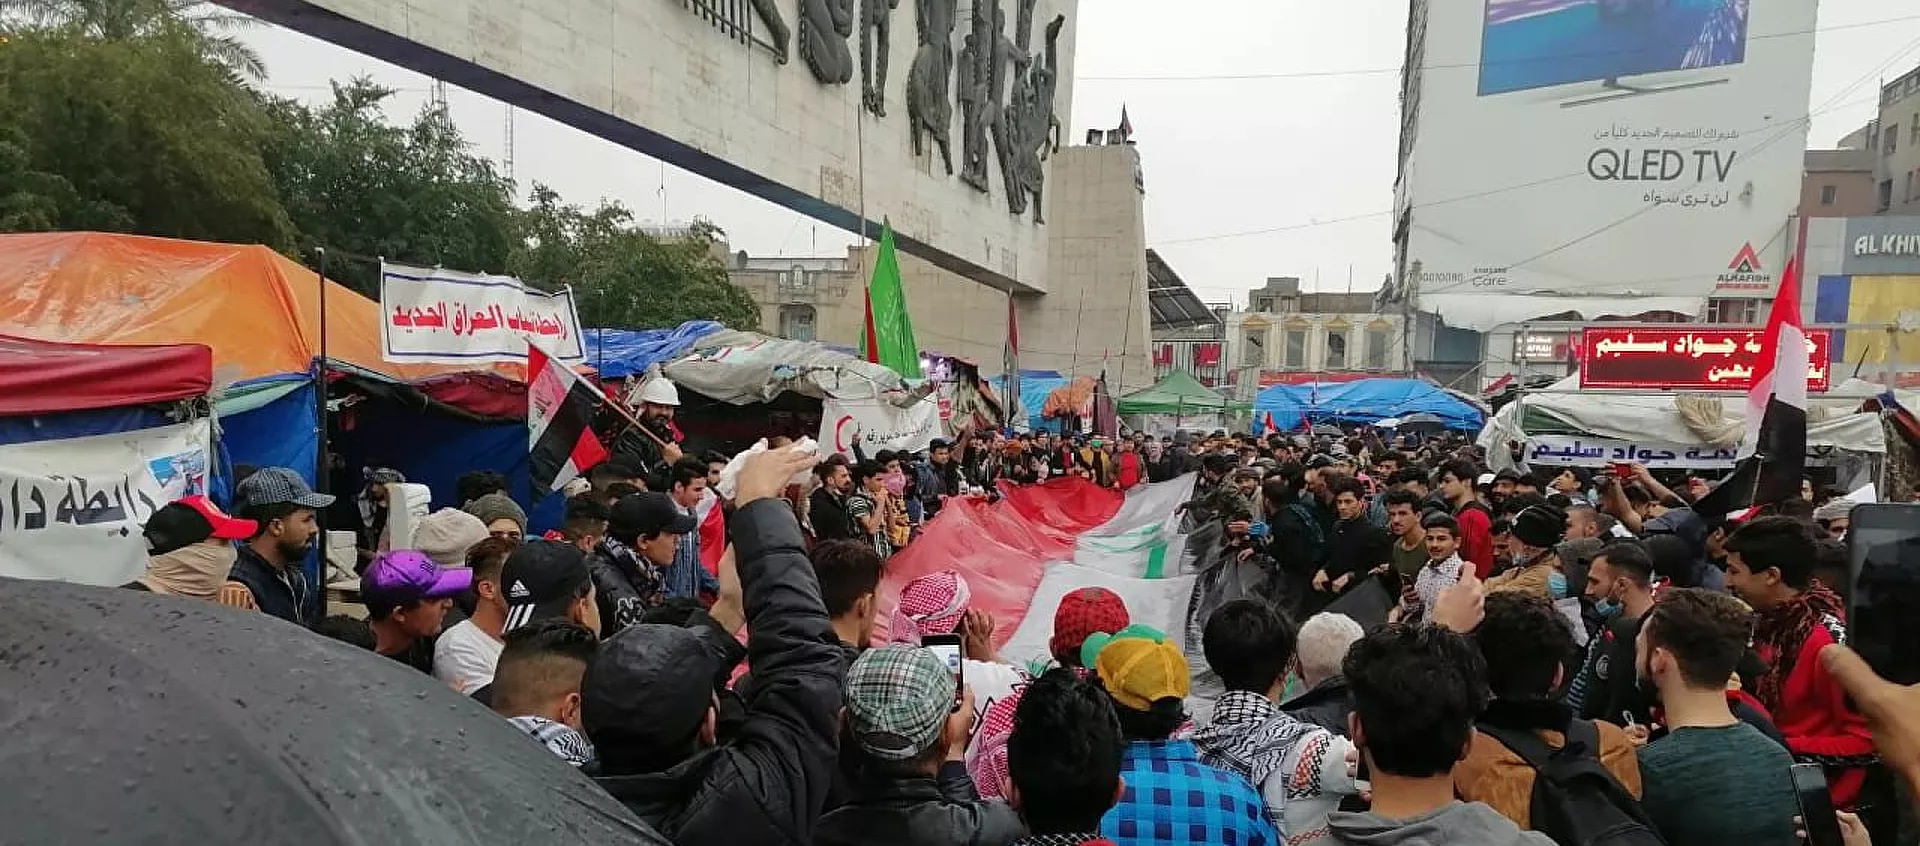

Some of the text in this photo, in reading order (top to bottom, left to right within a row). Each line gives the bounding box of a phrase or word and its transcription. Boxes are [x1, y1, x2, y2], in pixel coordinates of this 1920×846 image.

[1588, 148, 1738, 182] QLED TV
[1855, 235, 1878, 256] AL
[1473, 276, 1507, 287] Care
[392, 301, 448, 333] الجديد
[452, 302, 504, 336] العراق
[1596, 332, 1668, 358] سليم
[1673, 334, 1738, 358] جواد
[1531, 441, 1604, 461] سليم
[1612, 442, 1676, 464] جواد
